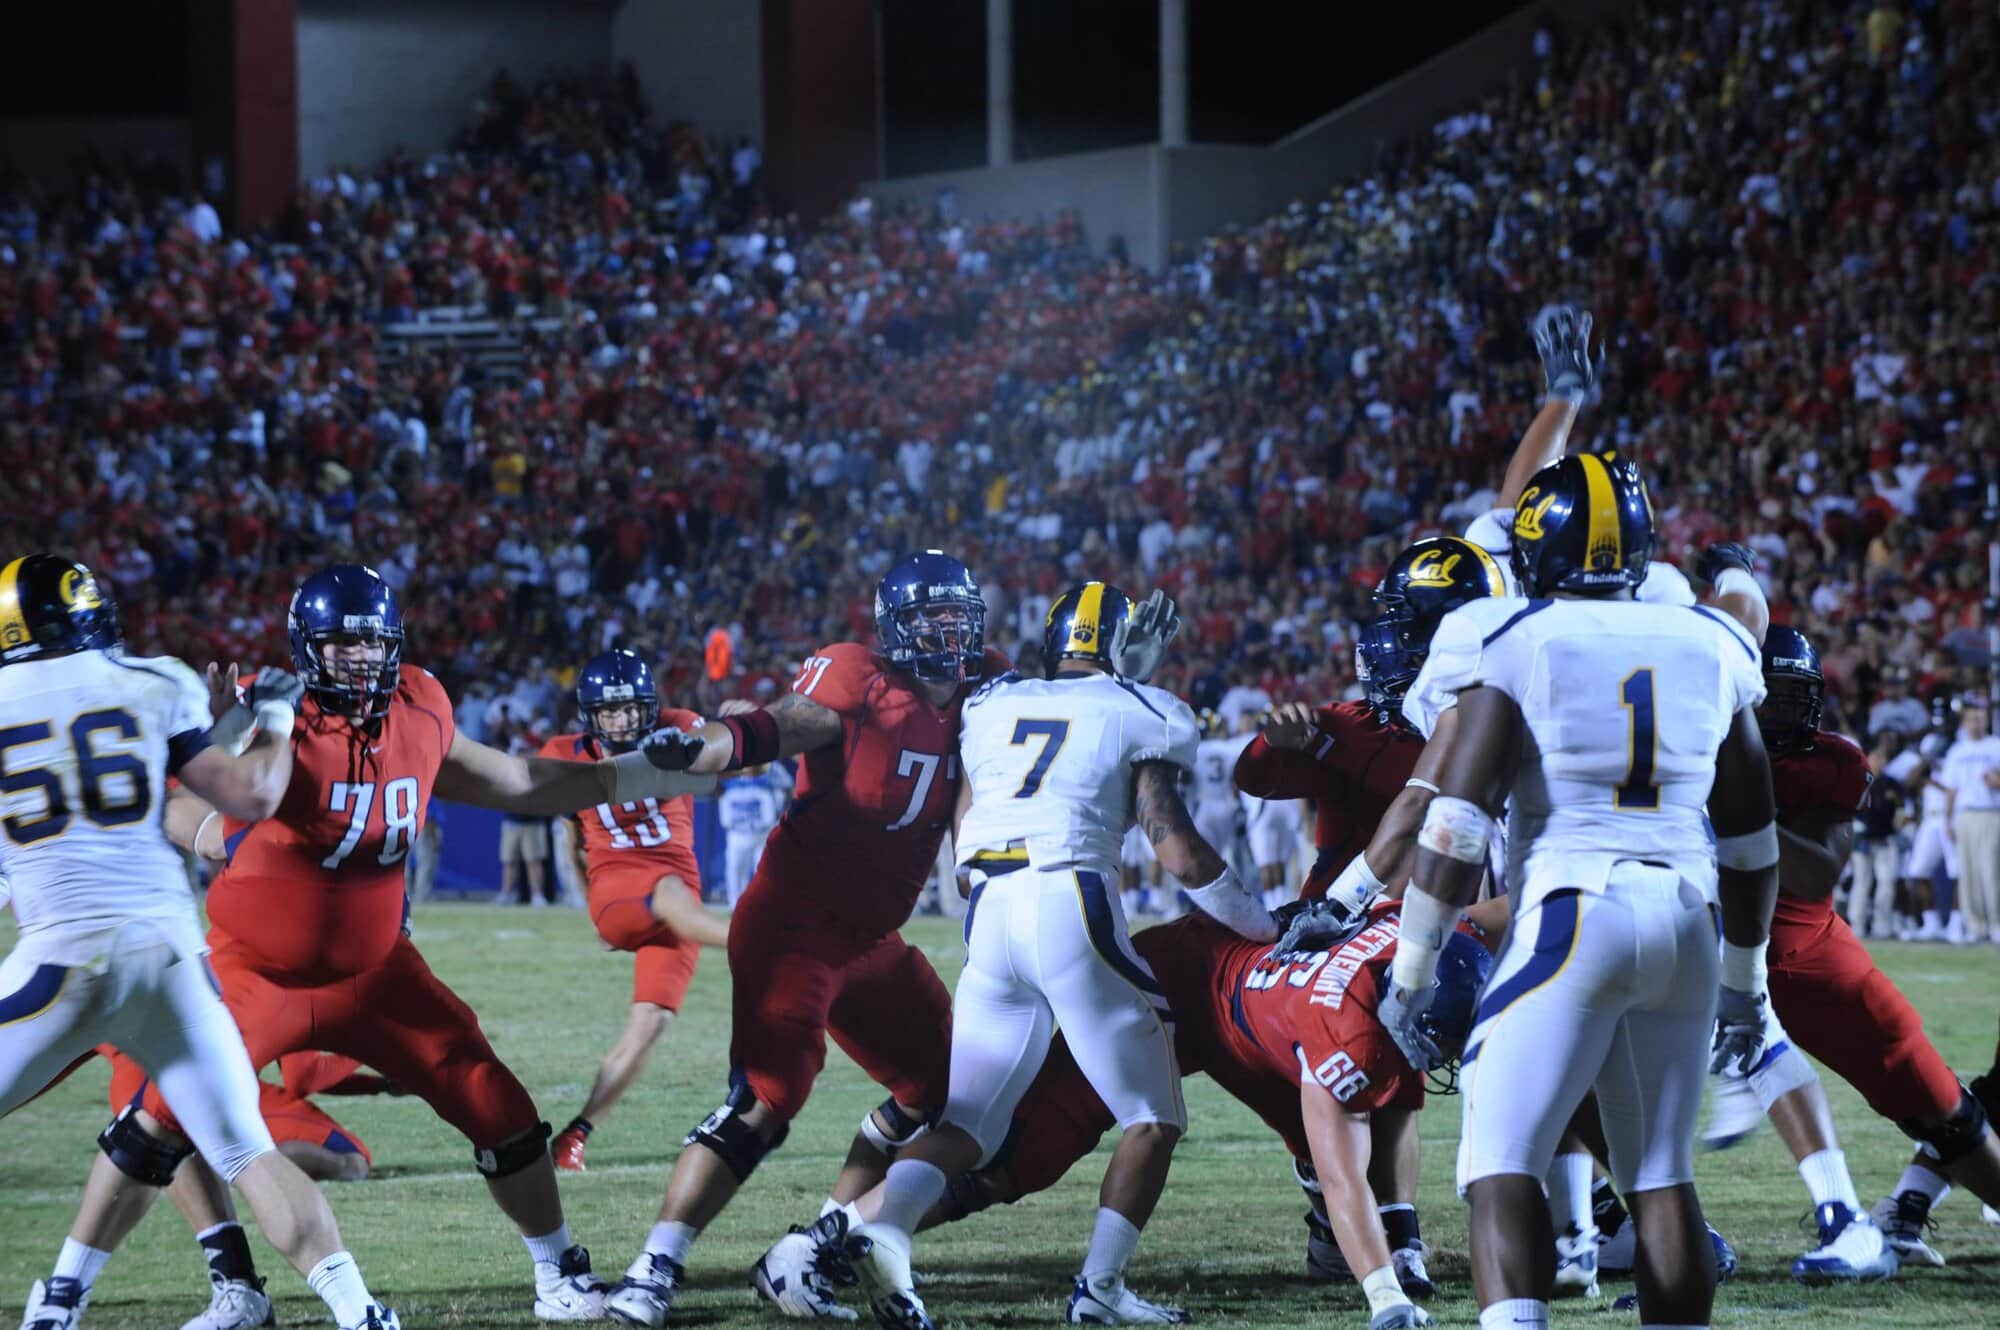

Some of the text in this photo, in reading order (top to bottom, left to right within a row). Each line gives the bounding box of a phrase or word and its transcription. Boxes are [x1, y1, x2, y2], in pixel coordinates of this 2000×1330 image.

[1406, 549, 1462, 587] Cal
[0, 708, 152, 845] 56
[1009, 719, 1072, 798] 7
[1613, 667, 1662, 813] 1
[321, 776, 419, 870] 78
[886, 748, 958, 831] 7
